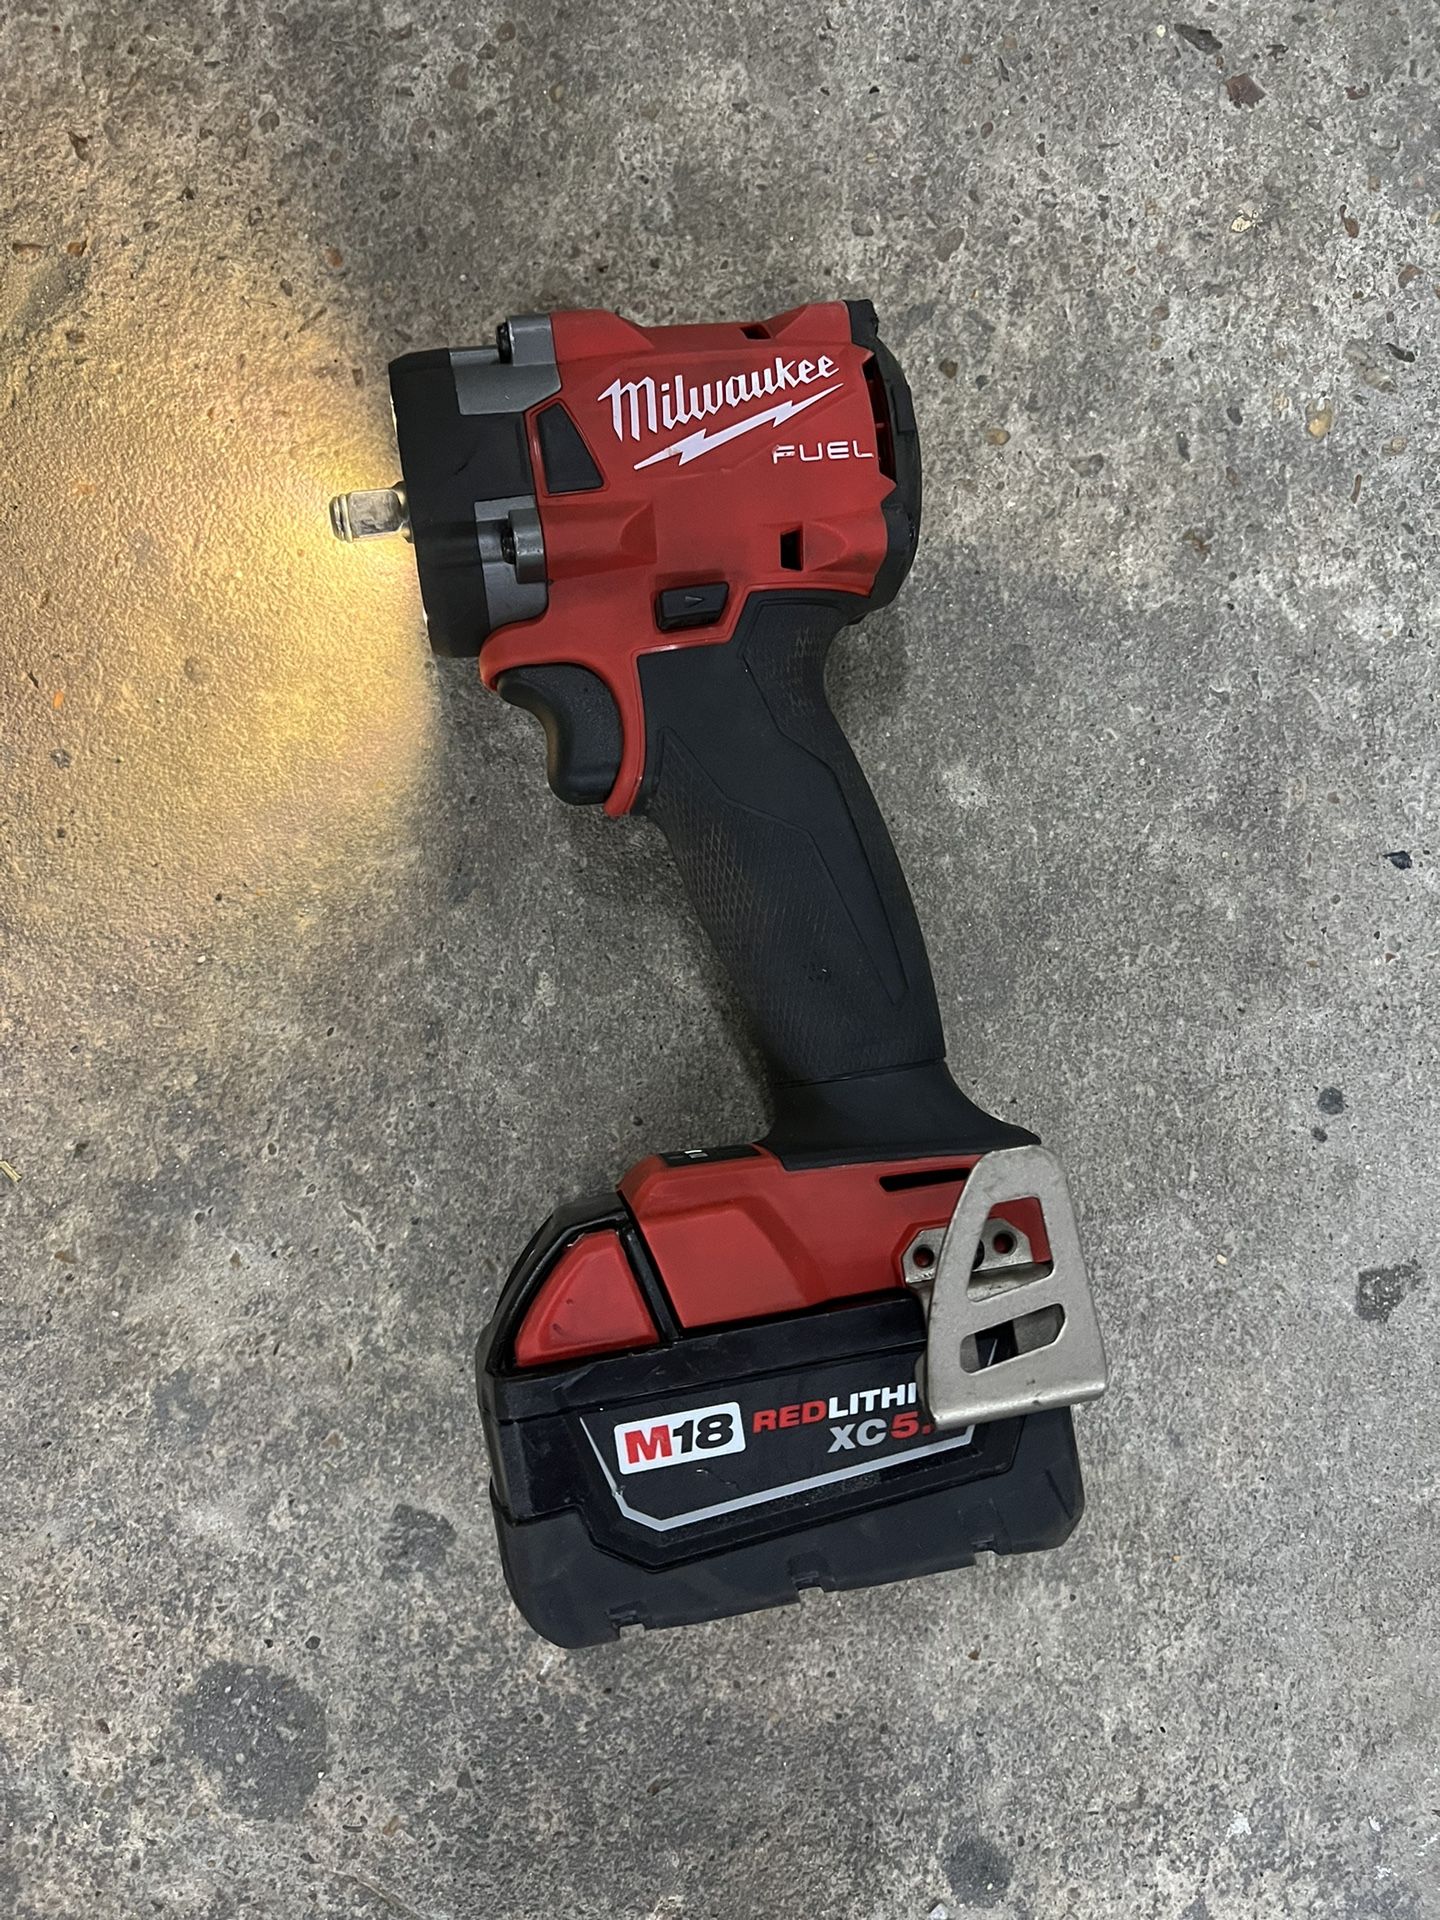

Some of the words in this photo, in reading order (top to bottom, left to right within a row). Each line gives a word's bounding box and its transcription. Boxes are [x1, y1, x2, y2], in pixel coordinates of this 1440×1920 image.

[597, 355, 840, 442] Milwaukee
[772, 440, 874, 464] FUEL
[625, 1413, 734, 1464] M18
[752, 1382, 917, 1434] REDLITHI
[827, 1411, 934, 1453] XC5.
